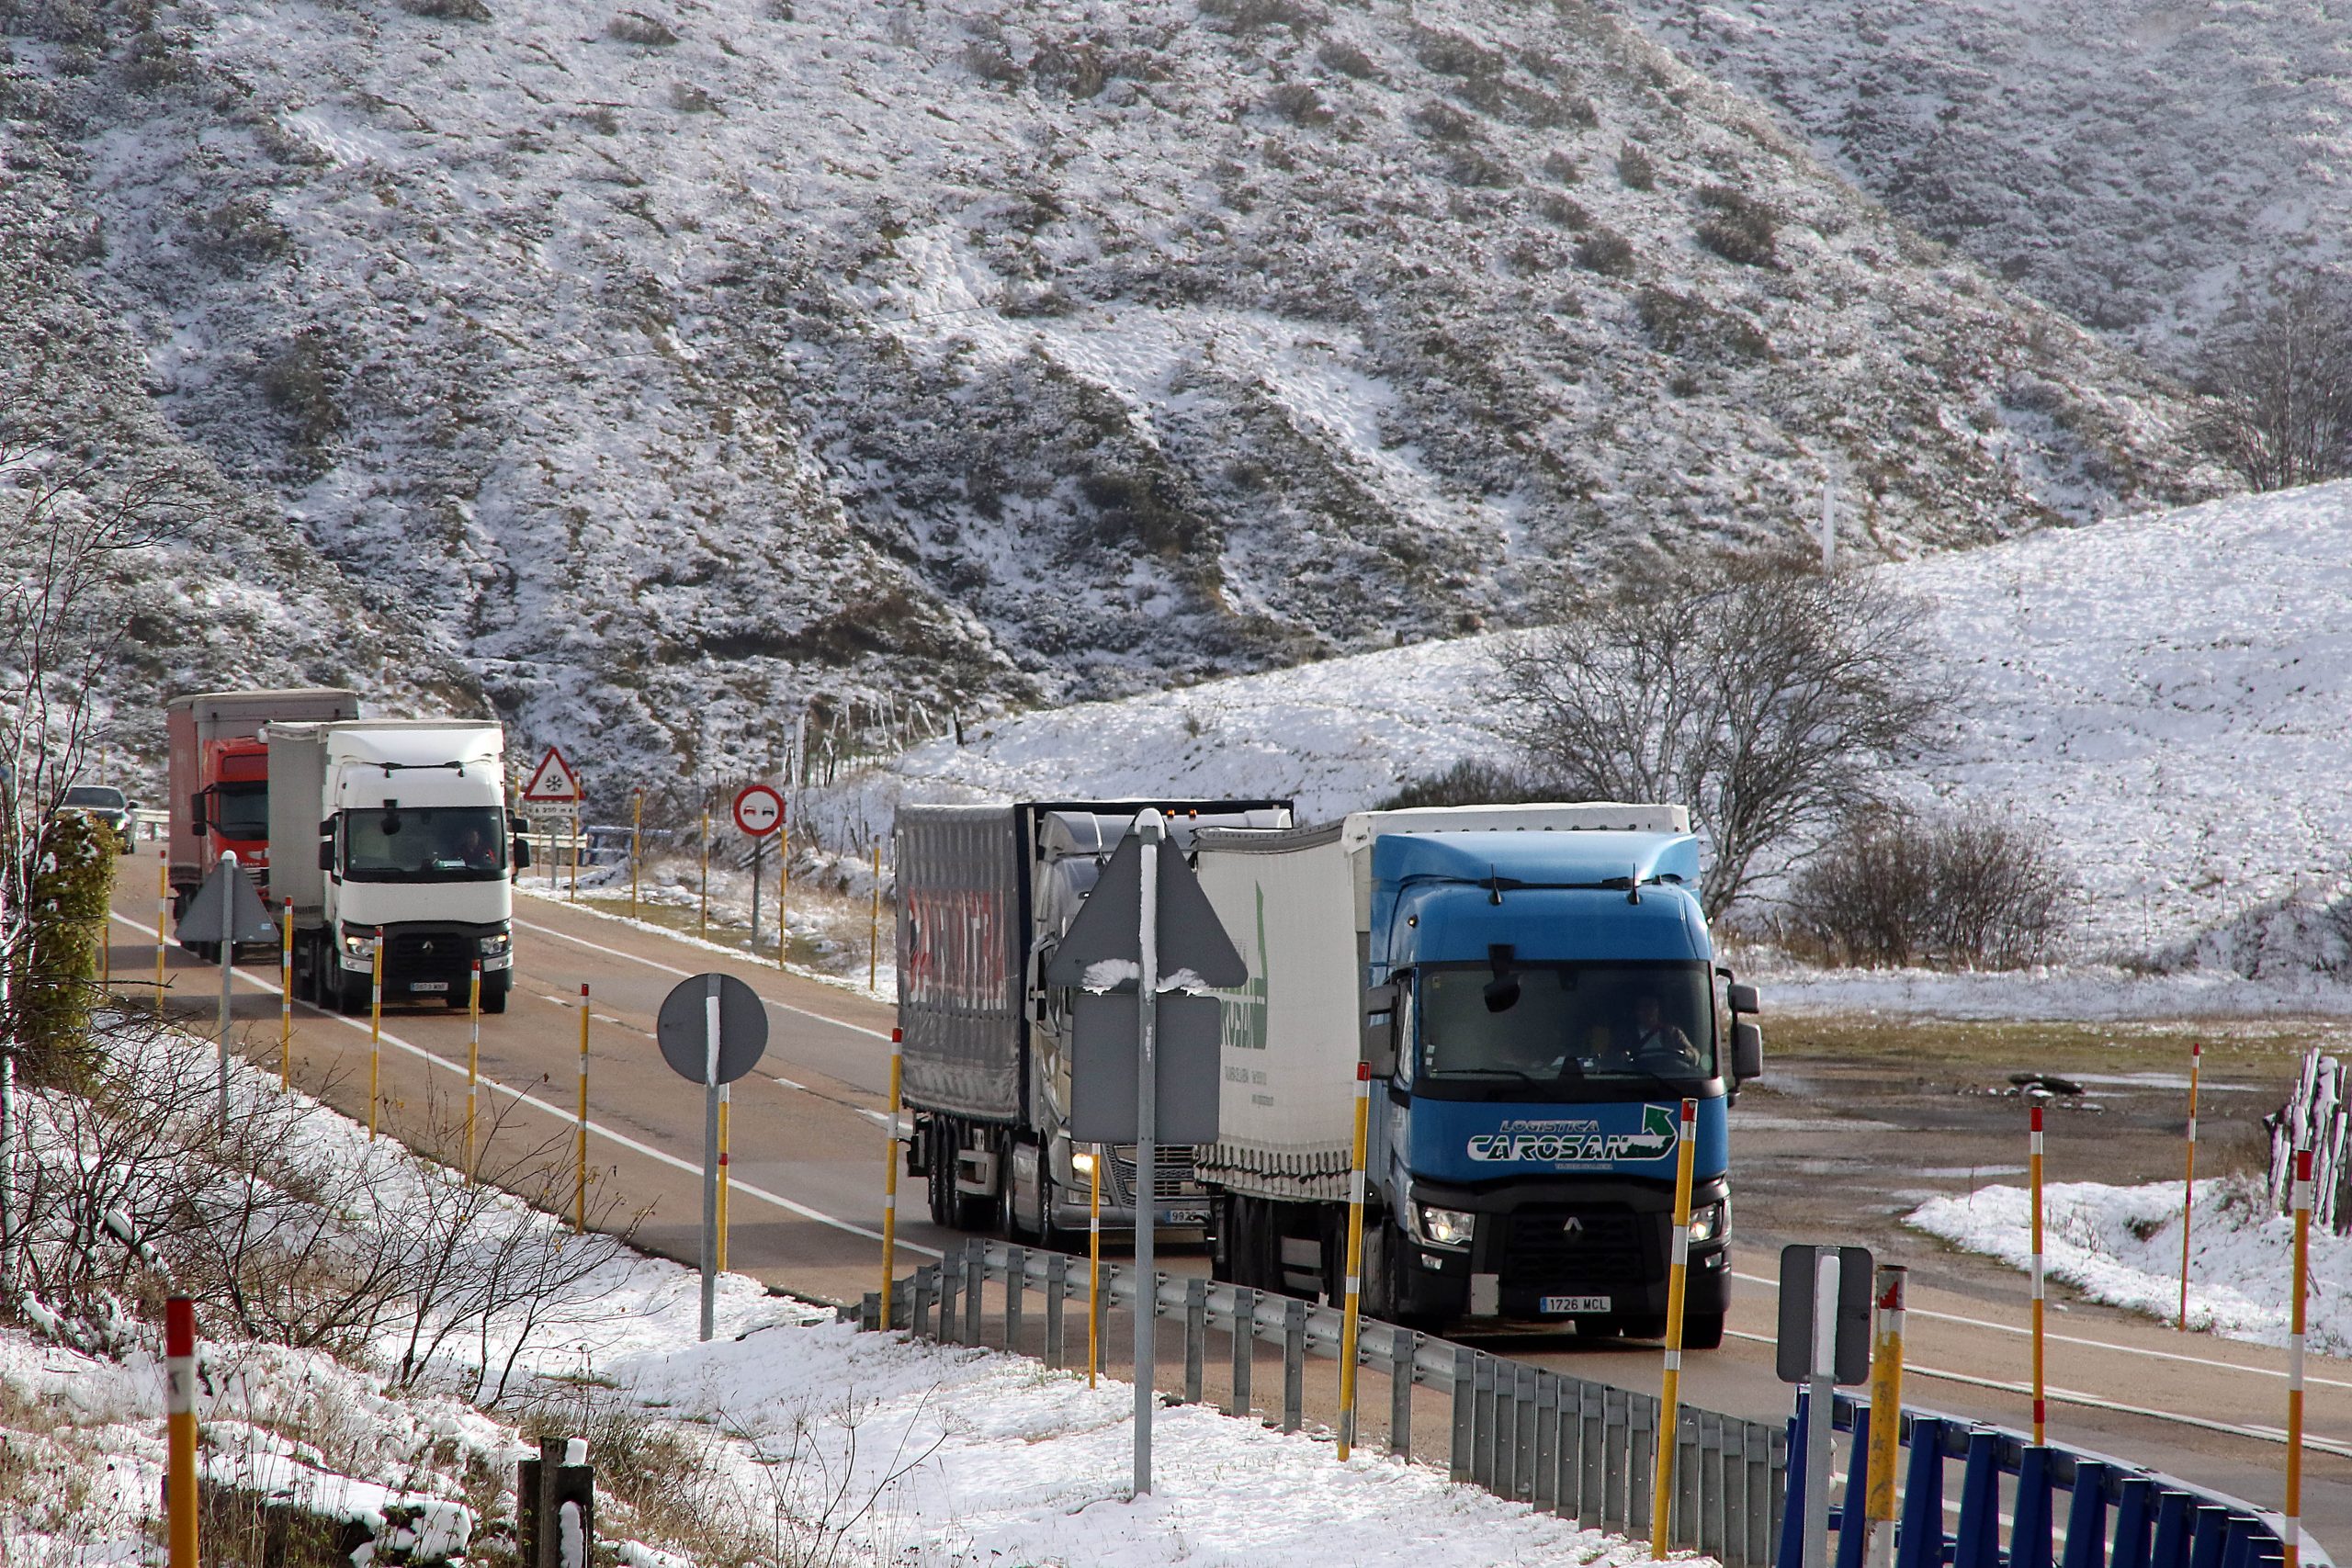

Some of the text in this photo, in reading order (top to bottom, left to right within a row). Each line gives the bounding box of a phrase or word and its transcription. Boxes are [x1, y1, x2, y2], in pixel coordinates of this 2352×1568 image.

[1499, 1120, 1600, 1132] LOGISTICA
[1467, 1134, 1629, 1161] CAROSAN
[1550, 1298, 1607, 1311] 1726 MCL
